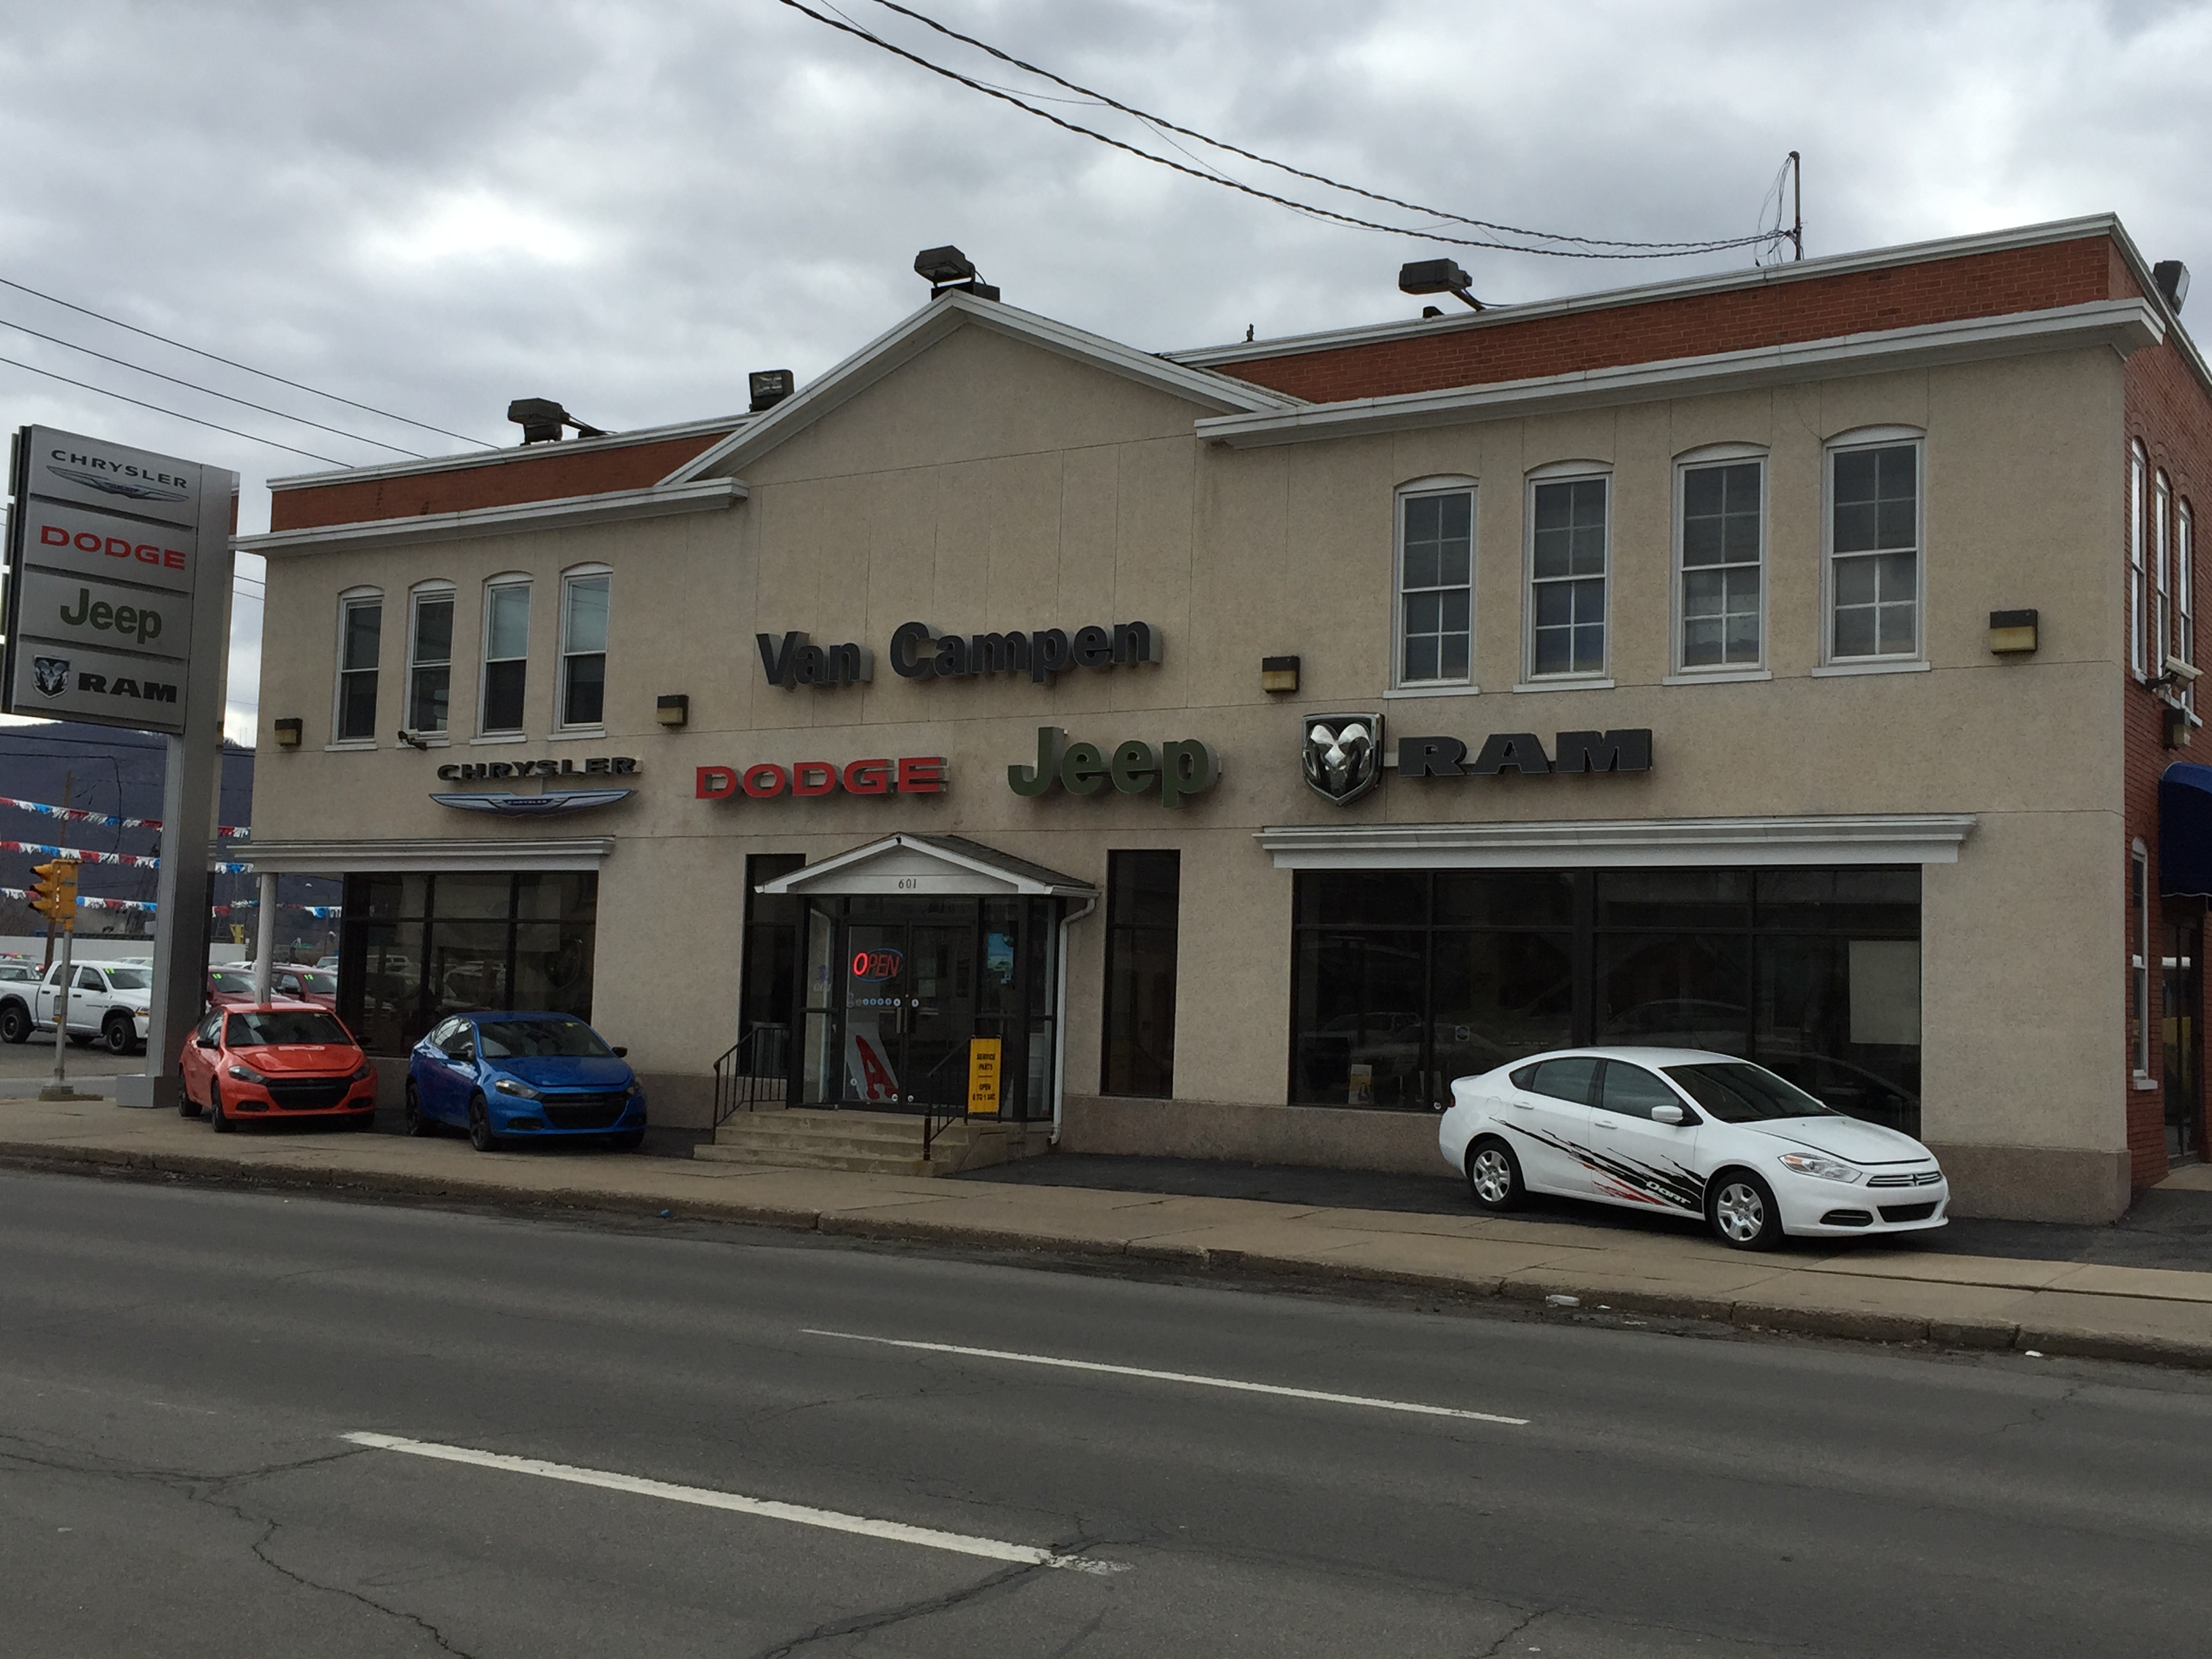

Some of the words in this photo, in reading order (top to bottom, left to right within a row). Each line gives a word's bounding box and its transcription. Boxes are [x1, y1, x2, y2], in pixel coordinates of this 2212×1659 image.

[51, 450, 187, 489] CHRYSLER
[41, 525, 186, 570] DODGE
[60, 588, 163, 644] Jeep
[756, 631, 870, 686] Van
[890, 621, 1156, 684] Campen
[78, 672, 177, 703] RAM
[437, 756, 640, 780] CHRYSLER
[1008, 726, 1218, 808] Jeep
[1398, 729, 1652, 777] RAM
[695, 756, 947, 799] DODGE
[898, 878, 917, 889] 601
[853, 951, 901, 977] OPEN
